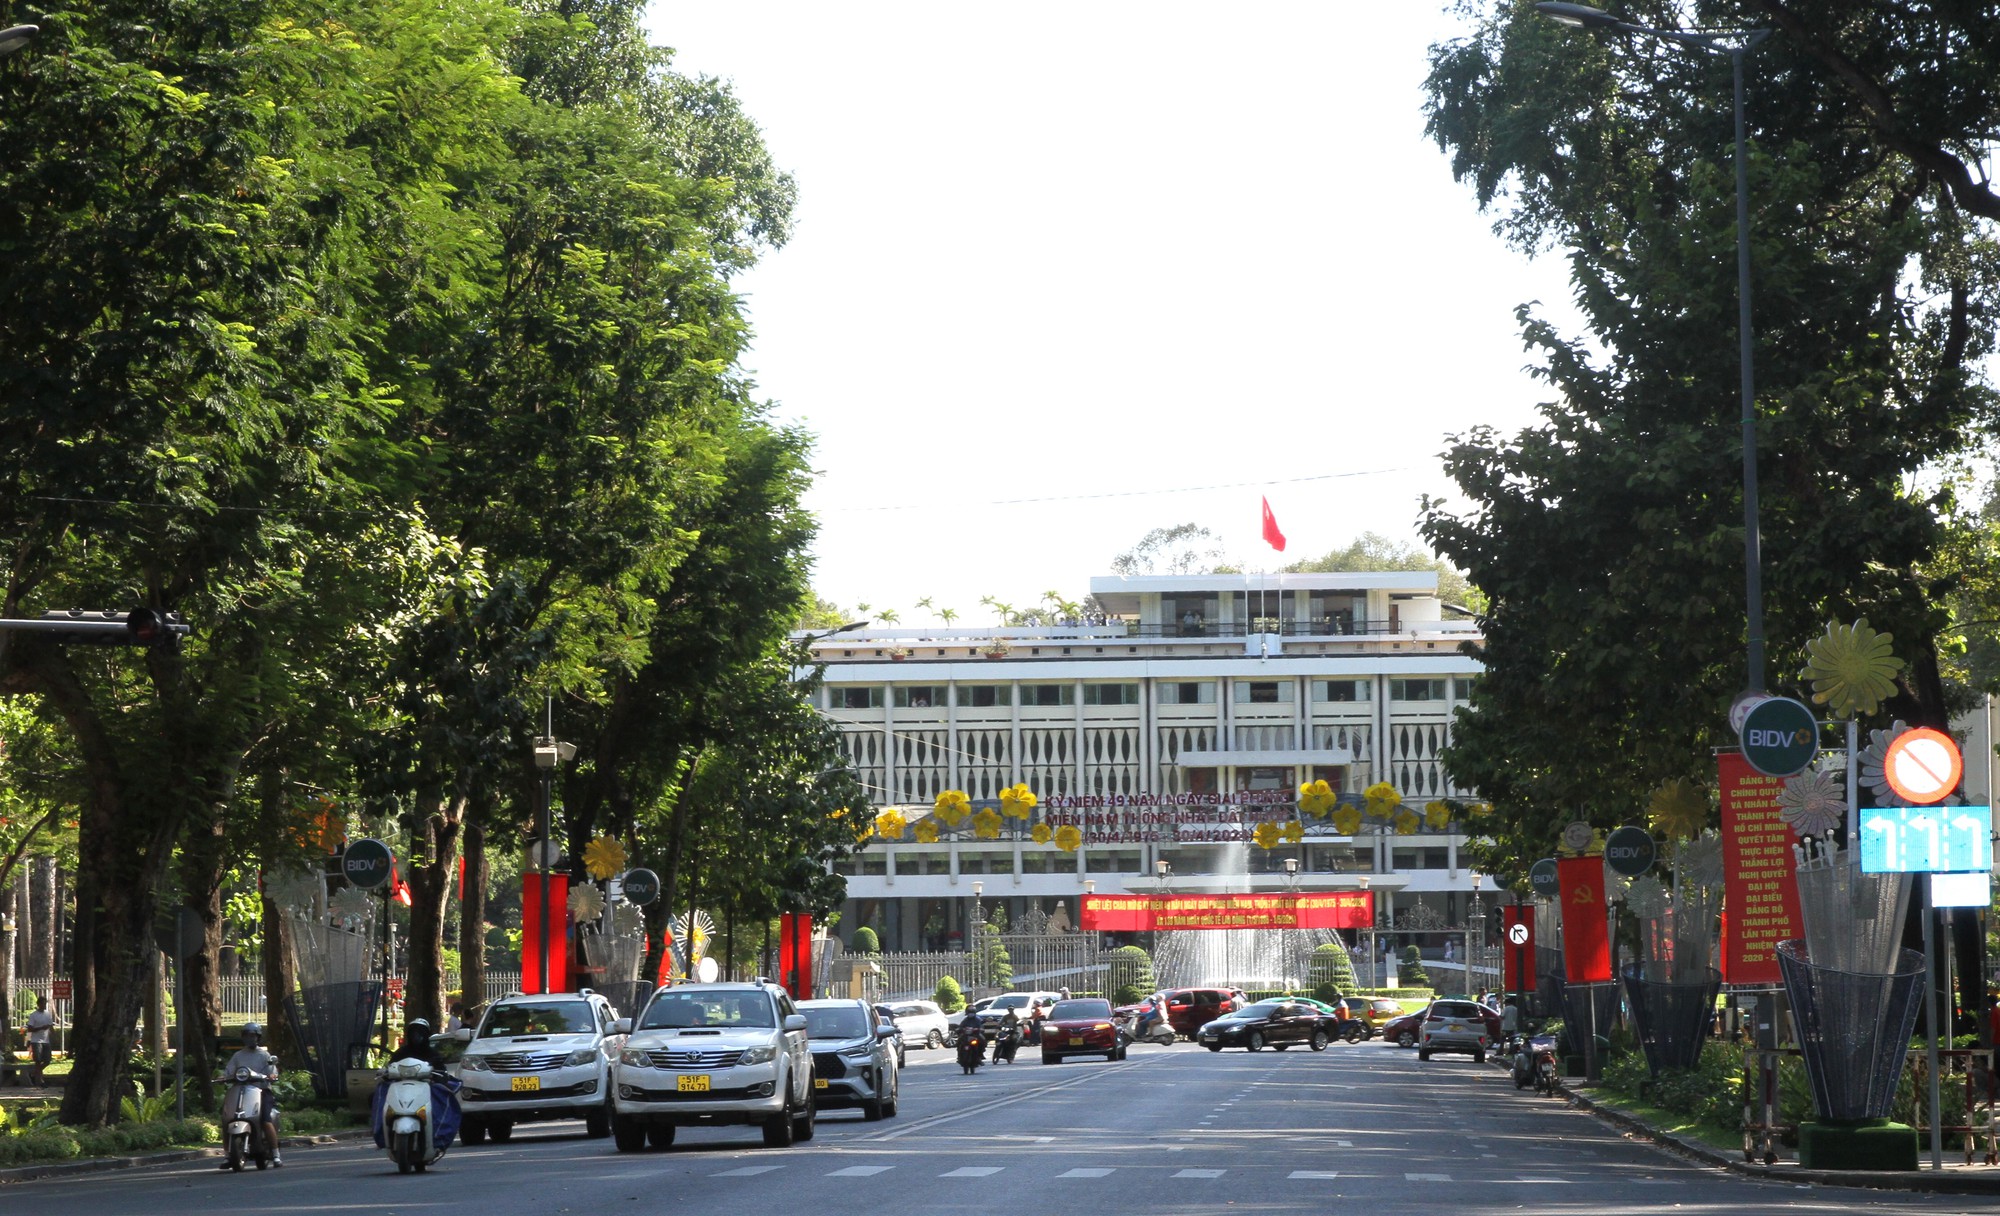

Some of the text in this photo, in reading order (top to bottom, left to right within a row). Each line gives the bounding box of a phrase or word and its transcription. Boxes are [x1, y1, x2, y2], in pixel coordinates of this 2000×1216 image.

[1749, 729, 1796, 748] BIDV
[1739, 775, 1763, 785] ĐẢNG
[1730, 787, 1757, 797] CHÍNH
[1107, 794, 1125, 806] 49
[1128, 790, 1162, 806] NĂM
[1731, 799, 1742, 809] VÀ
[1744, 798, 1768, 808] NHÂN
[1084, 814, 1119, 825] NAM
[1736, 811, 1765, 821] THÀNH
[1734, 822, 1788, 832] HỒ CHÍ MINH
[1738, 834, 1785, 845] QUYẾT TÂM
[1610, 847, 1641, 859] BIDV
[1739, 845, 1784, 857] THỰC HIỆN
[347, 859, 376, 871] BIDV
[1533, 874, 1556, 884] BIDV
[1738, 868, 1788, 880] NGHỊ QUYẾT
[626, 883, 648, 893] BIDV
[1748, 881, 1779, 892] ĐẠI HỘI
[1746, 894, 1761, 904] ĐẠI
[1772, 904, 1783, 915] BỘ
[1742, 914, 1789, 927] THÀNH PHỐ
[1761, 928, 1778, 937] THỨ
[1780, 928, 1792, 937] XI
[1746, 941, 1774, 952] NHIỆM
[1742, 954, 1763, 963] 2020
[686, 1075, 701, 1083] 51F
